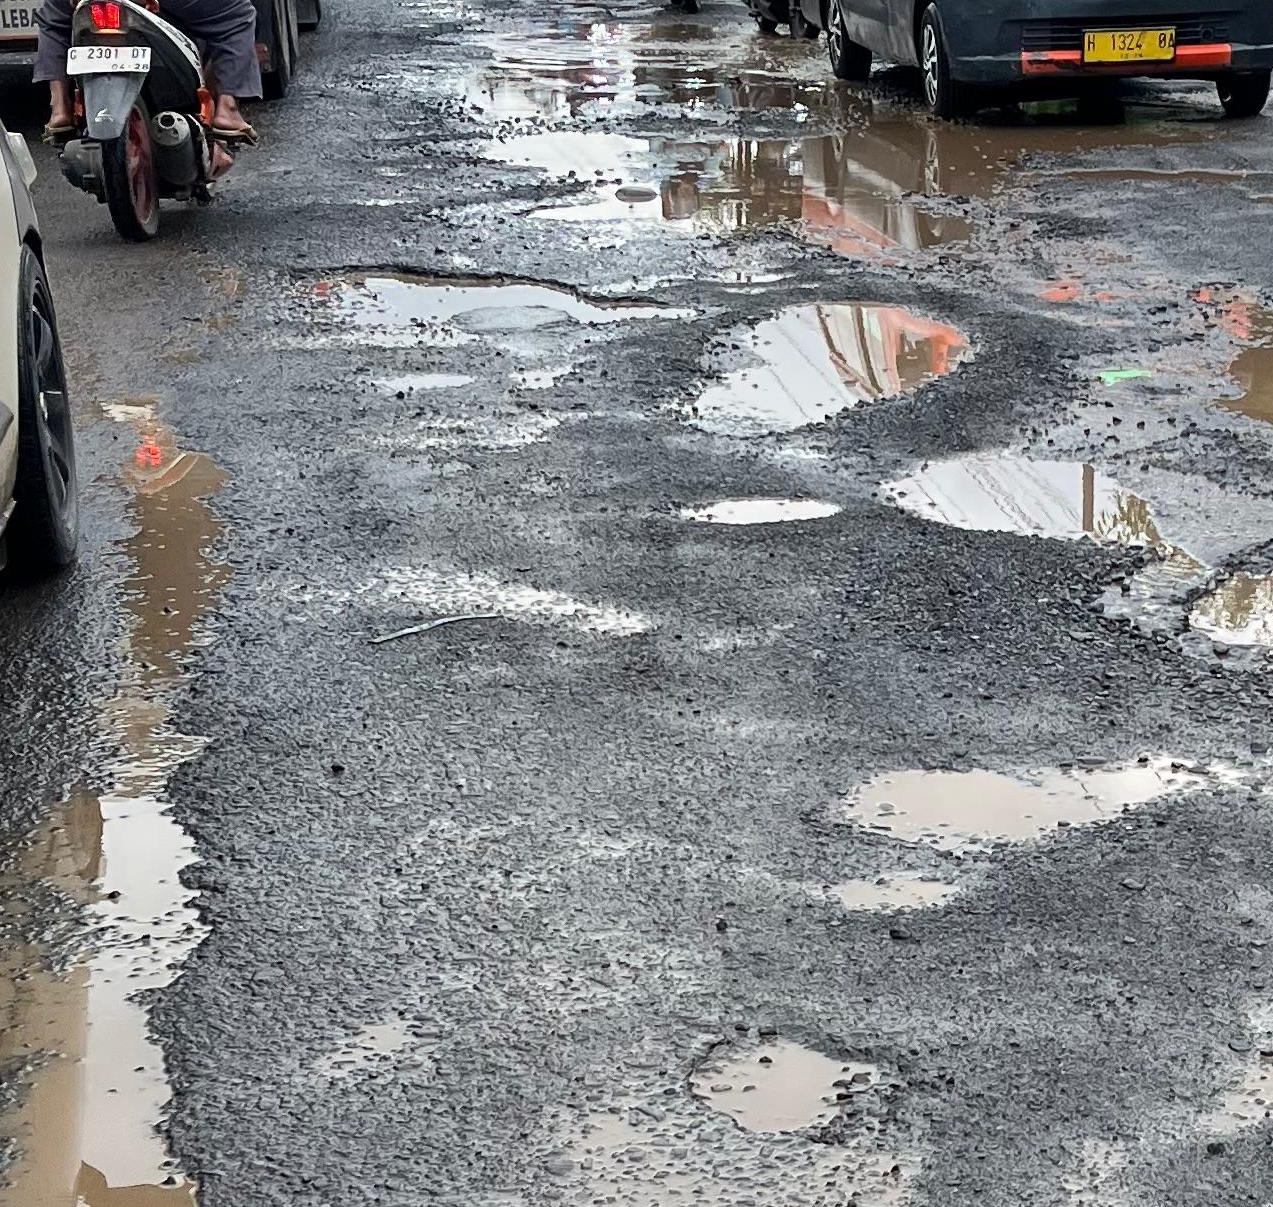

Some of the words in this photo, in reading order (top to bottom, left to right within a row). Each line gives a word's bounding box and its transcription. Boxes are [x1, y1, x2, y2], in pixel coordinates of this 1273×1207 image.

[1087, 34, 1096, 52] H
[1111, 32, 1144, 51] 1324
[87, 48, 119, 60] 2301
[132, 48, 147, 59] DT
